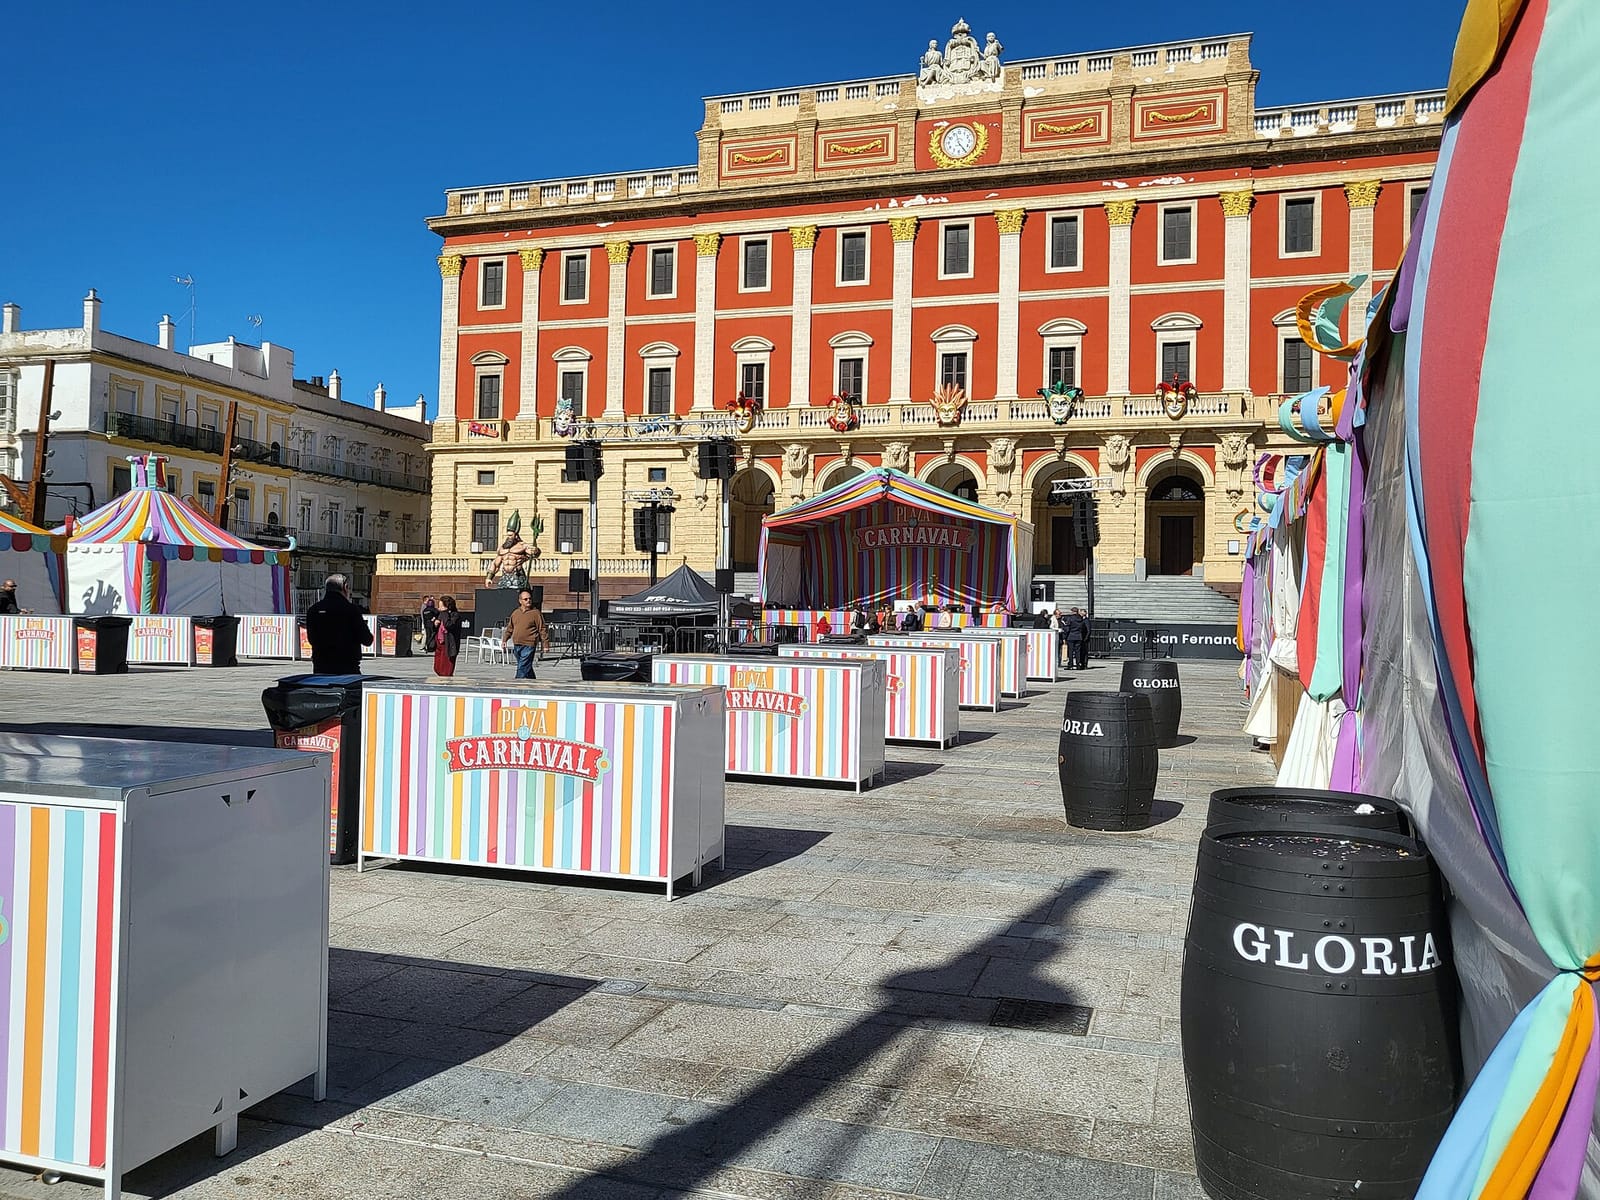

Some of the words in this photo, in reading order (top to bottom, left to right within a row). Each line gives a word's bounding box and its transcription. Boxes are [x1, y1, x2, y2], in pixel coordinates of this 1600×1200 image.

[864, 527, 962, 547] CARNAVAL
[736, 671, 768, 688] PLAZA
[1132, 678, 1178, 689] GLORIA
[501, 708, 547, 734] PLAZA
[1061, 719, 1104, 737] ORIA
[284, 735, 332, 749] CARNAVAL
[458, 740, 590, 775] CARNAVAL
[1233, 922, 1442, 976] GLORIA
